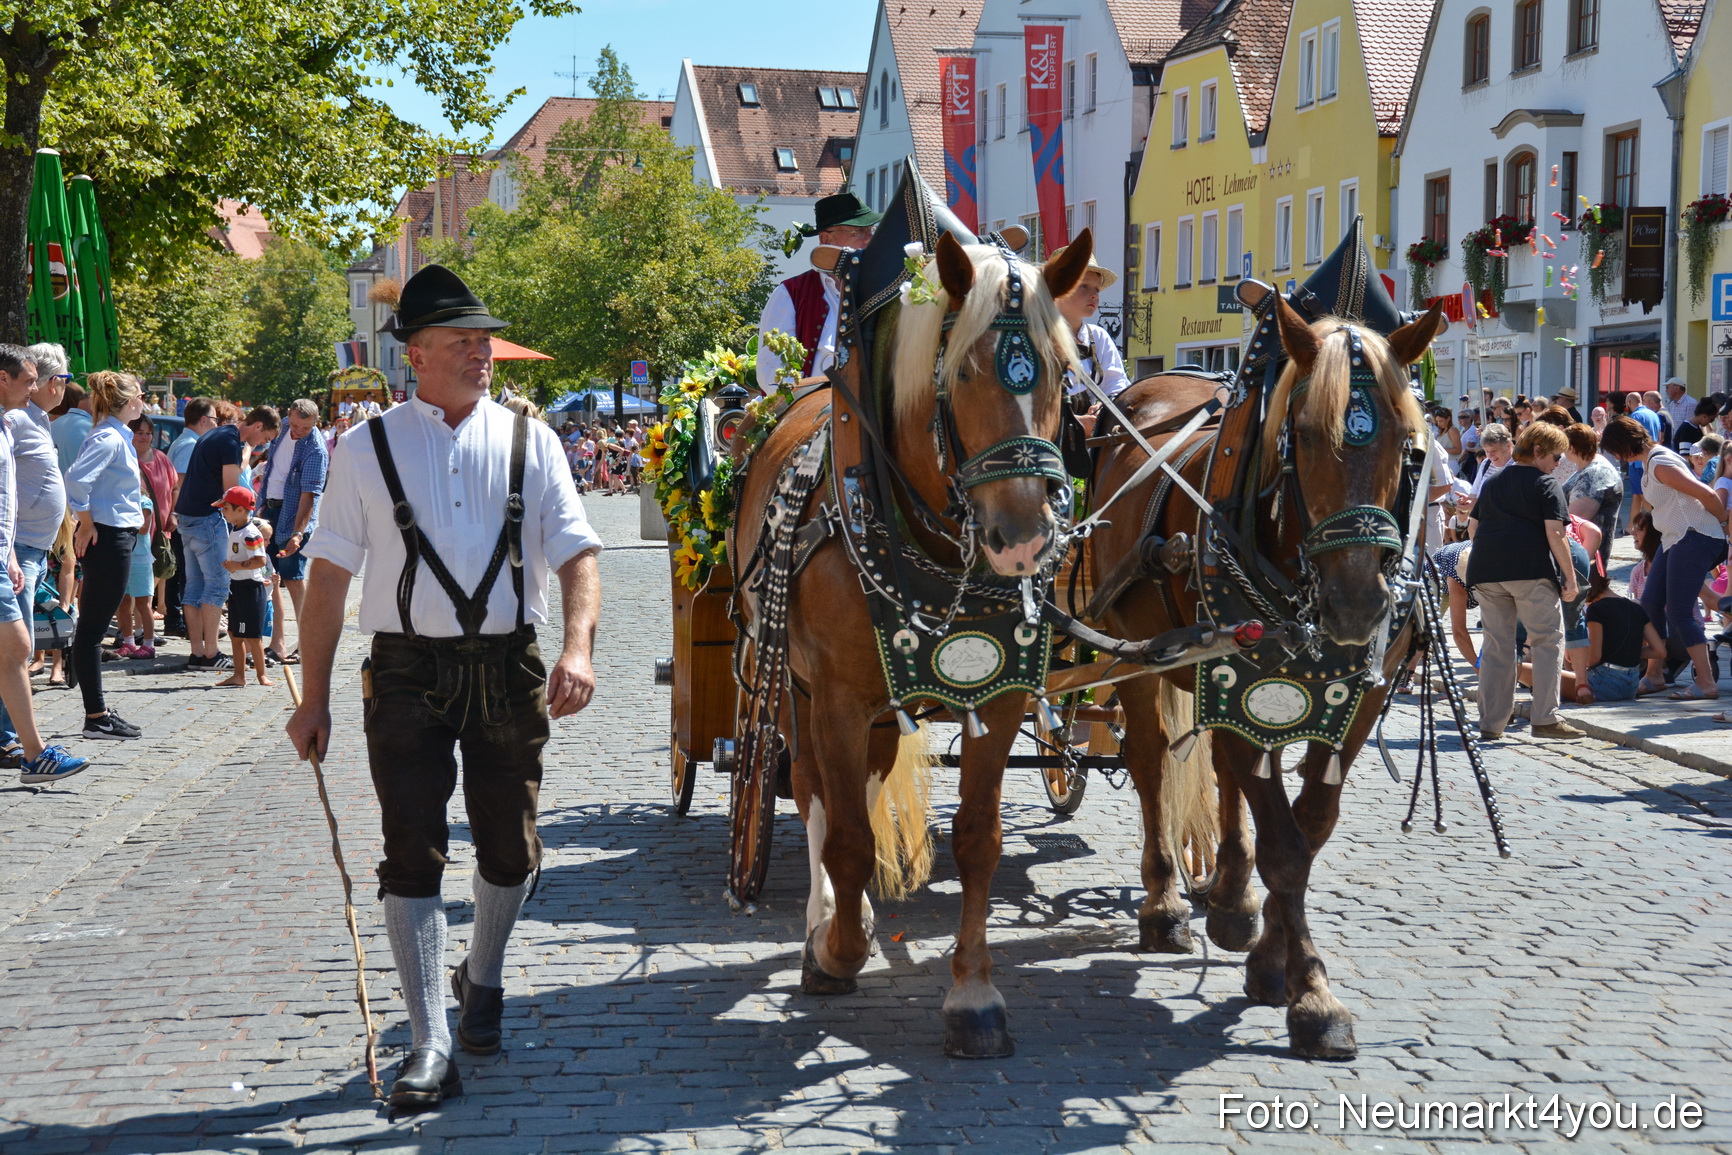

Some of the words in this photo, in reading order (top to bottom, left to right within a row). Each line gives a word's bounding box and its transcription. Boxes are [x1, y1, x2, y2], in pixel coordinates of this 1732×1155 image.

[1030, 34, 1049, 89] K&L
[1187, 176, 1215, 206] HOTEL
[1223, 169, 1258, 195] Lehmeier
[1244, 258, 1251, 278] P
[1220, 302, 1242, 310] TAIF
[1181, 316, 1222, 337] Restaurant
[34, 625, 51, 633] idoo
[238, 621, 246, 634] 10
